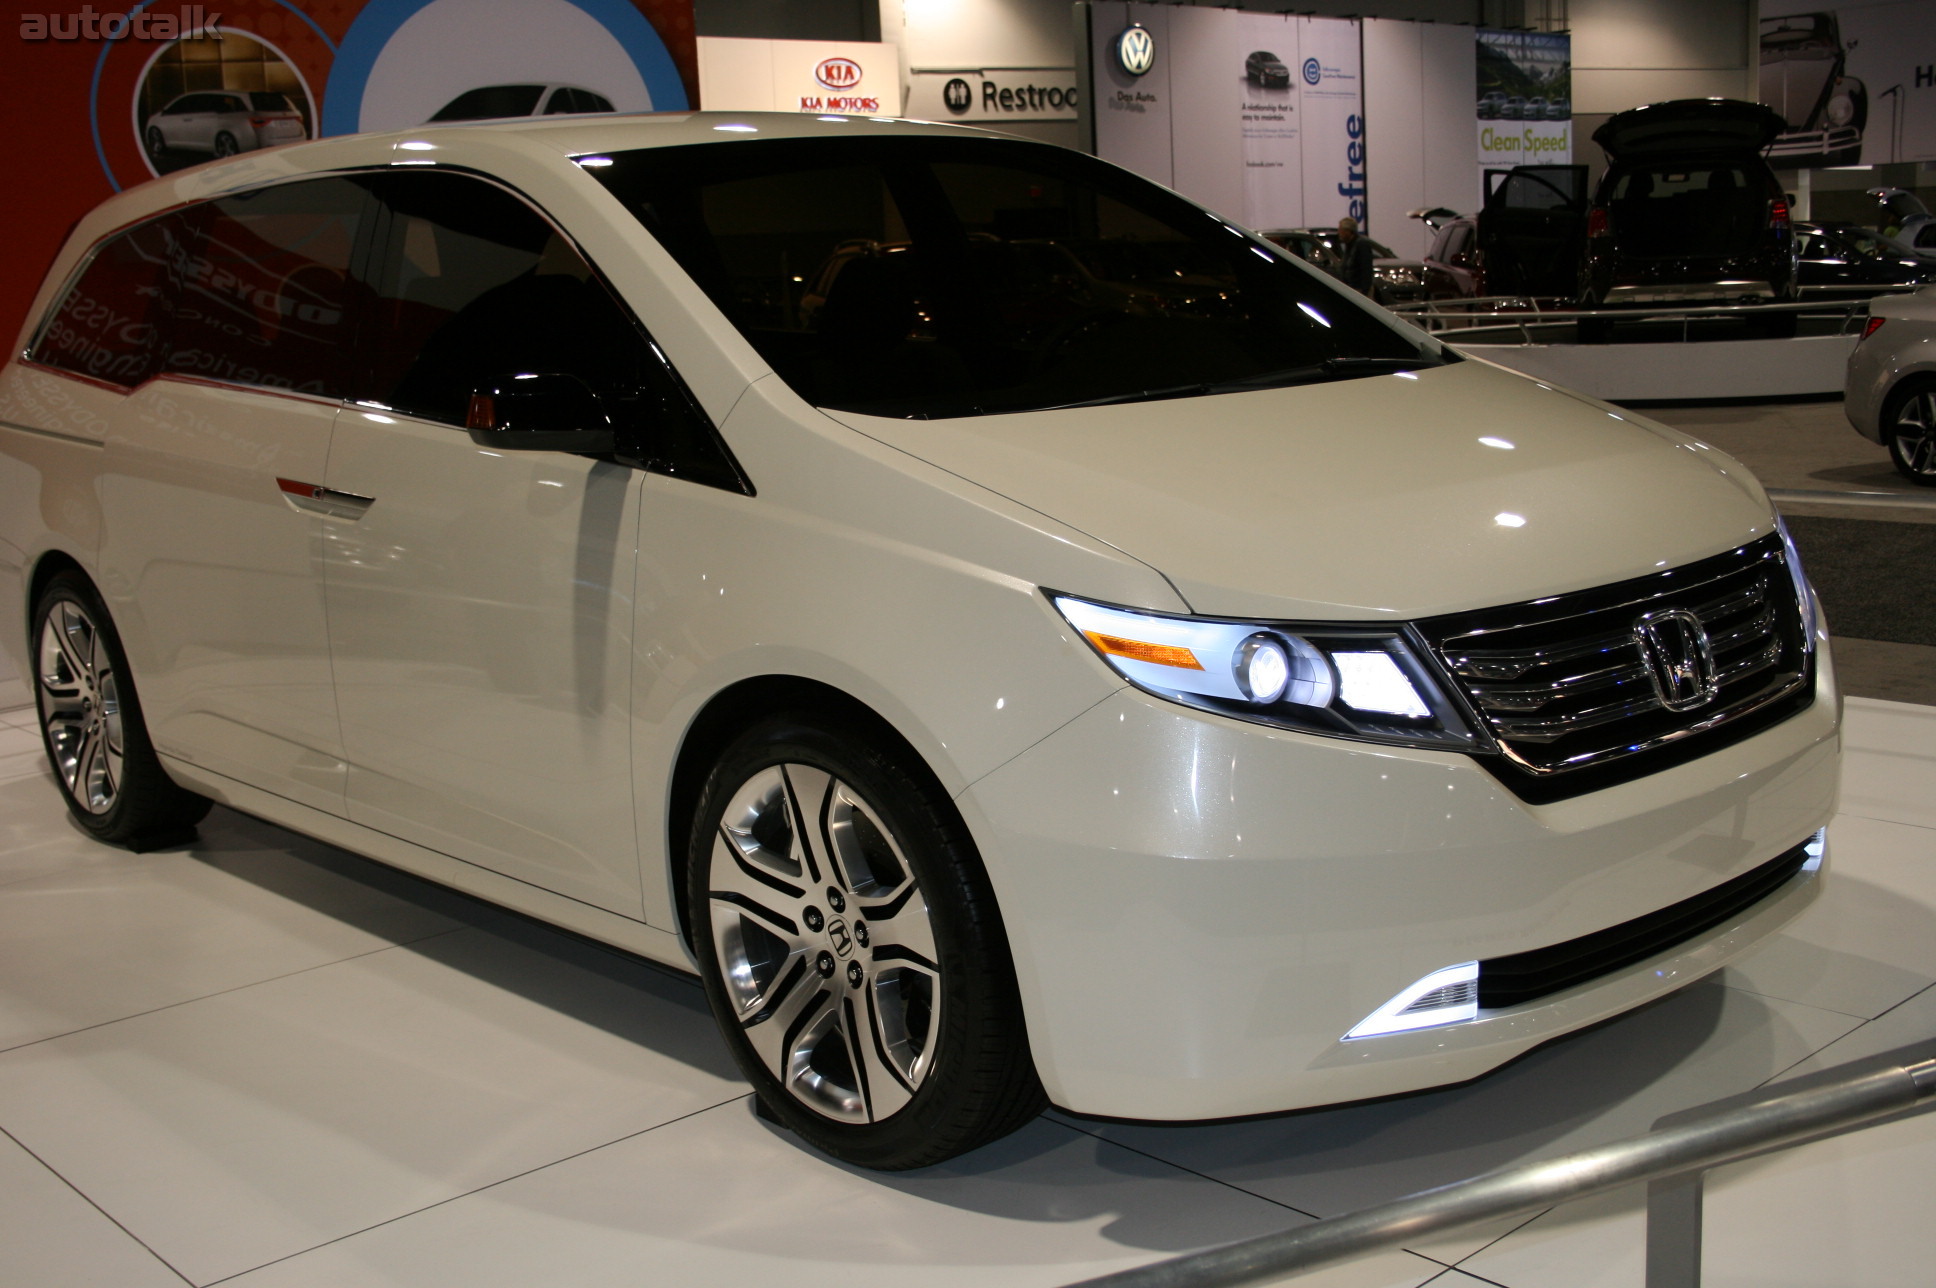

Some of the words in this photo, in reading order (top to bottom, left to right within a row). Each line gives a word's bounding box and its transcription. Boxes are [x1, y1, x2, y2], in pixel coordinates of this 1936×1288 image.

[824, 64, 855, 81] KIA
[1915, 65, 1936, 88] H
[800, 96, 823, 109] KIA
[826, 97, 879, 110] MOTORS
[1116, 91, 1133, 101] Das
[1481, 127, 1521, 151] Clean
[1524, 128, 1568, 158] Speed
[1338, 113, 1367, 237] efree
